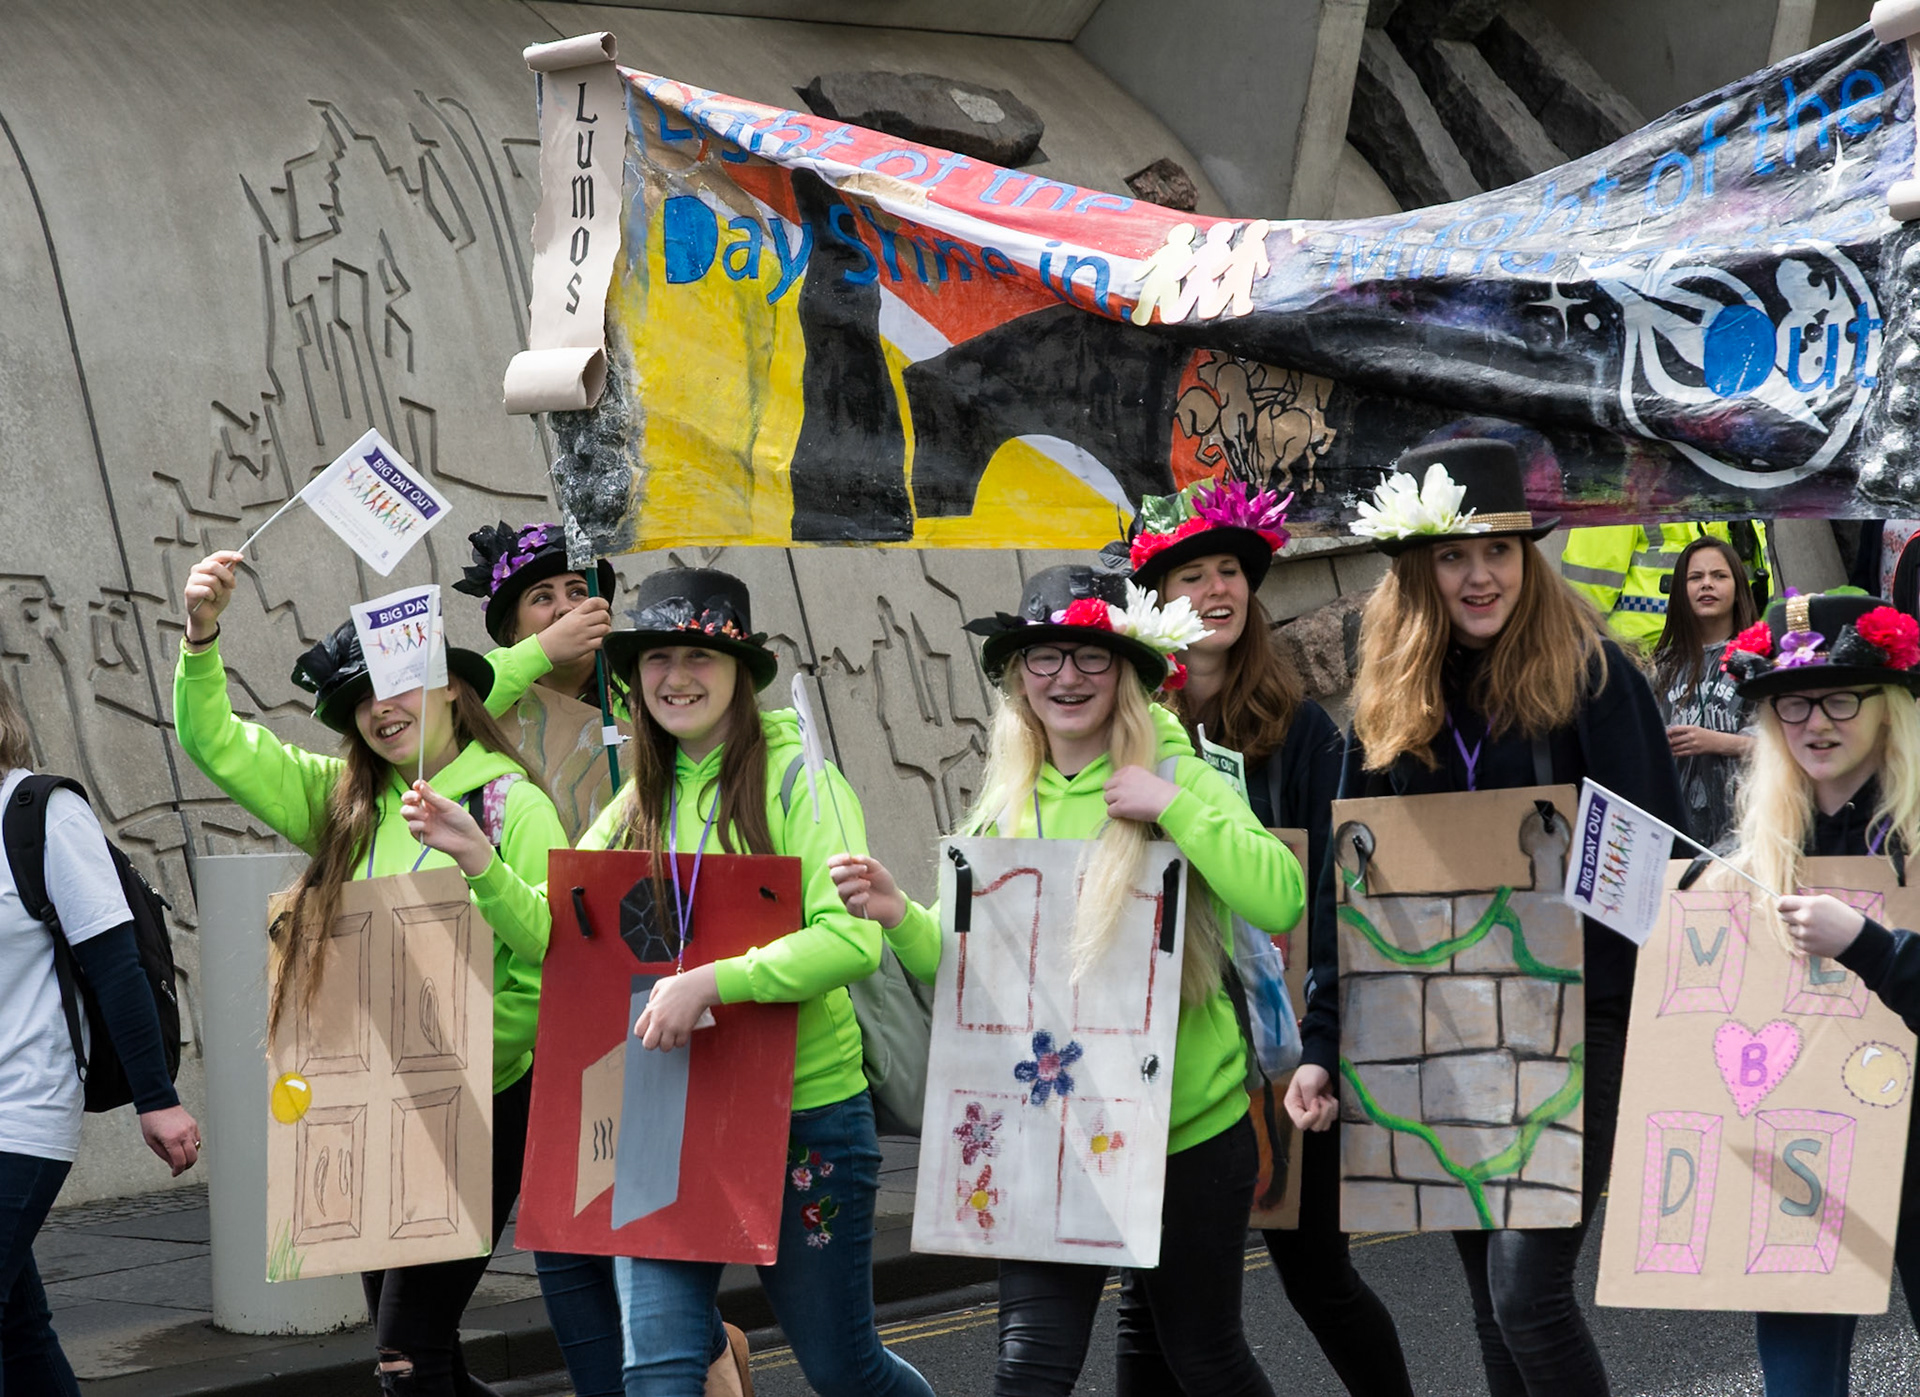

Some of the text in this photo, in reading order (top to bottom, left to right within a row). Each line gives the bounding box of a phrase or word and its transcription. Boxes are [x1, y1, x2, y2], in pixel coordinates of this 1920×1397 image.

[1644, 105, 1730, 216] of
[1750, 69, 1885, 175] the
[664, 195, 814, 305] Day
[1703, 301, 1884, 399] Out
[373, 458, 434, 511] BIG DAY OUT
[379, 607, 403, 624] BIG
[1580, 803, 1603, 892] BIG DAY OUT
[1685, 926, 1728, 967] W
[1740, 1043, 1768, 1088] B
[1661, 1138, 1828, 1218] D S
